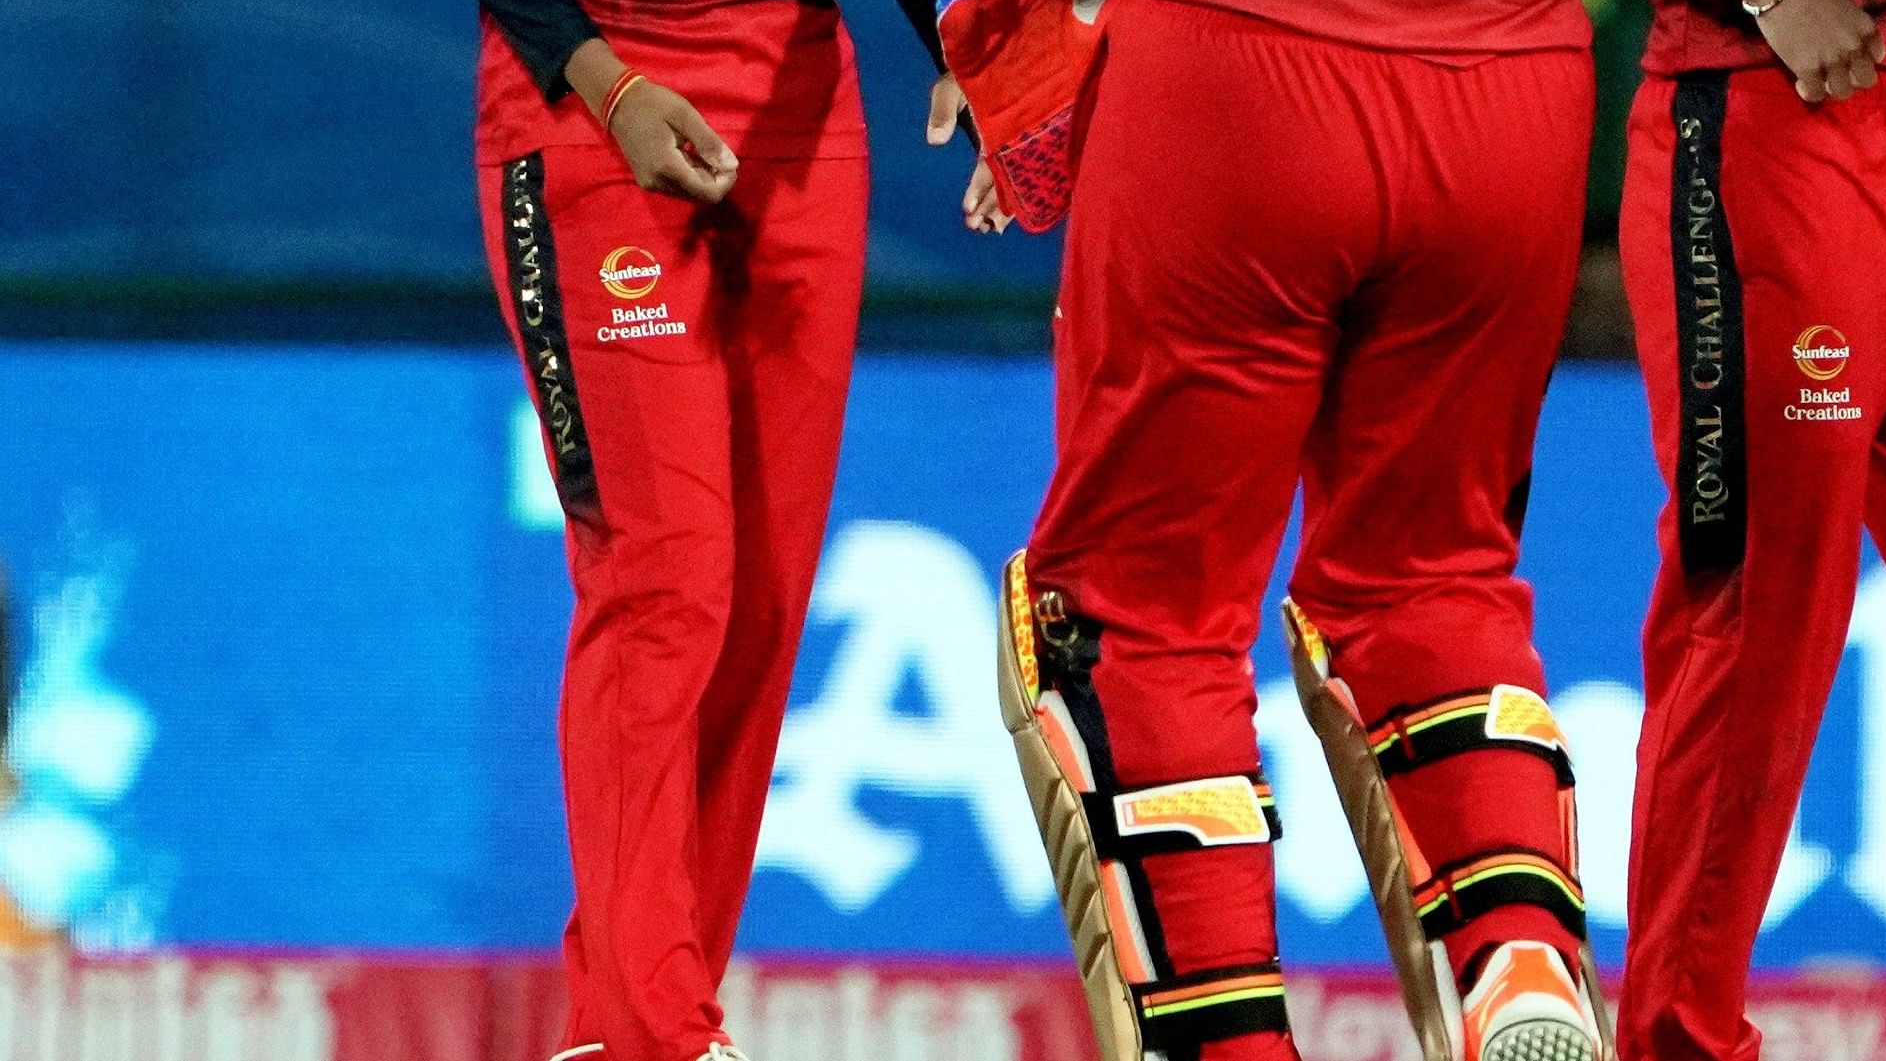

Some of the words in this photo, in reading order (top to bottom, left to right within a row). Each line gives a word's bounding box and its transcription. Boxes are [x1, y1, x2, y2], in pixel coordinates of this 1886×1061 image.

[599, 263, 662, 282] Sunfeast
[611, 303, 668, 324] Baked
[597, 321, 687, 342] Creations
[1792, 344, 1850, 359] Sunfeast
[1800, 387, 1850, 403] Baked
[1783, 405, 1862, 421] Creations
[1693, 405, 1728, 525] ROYAL
